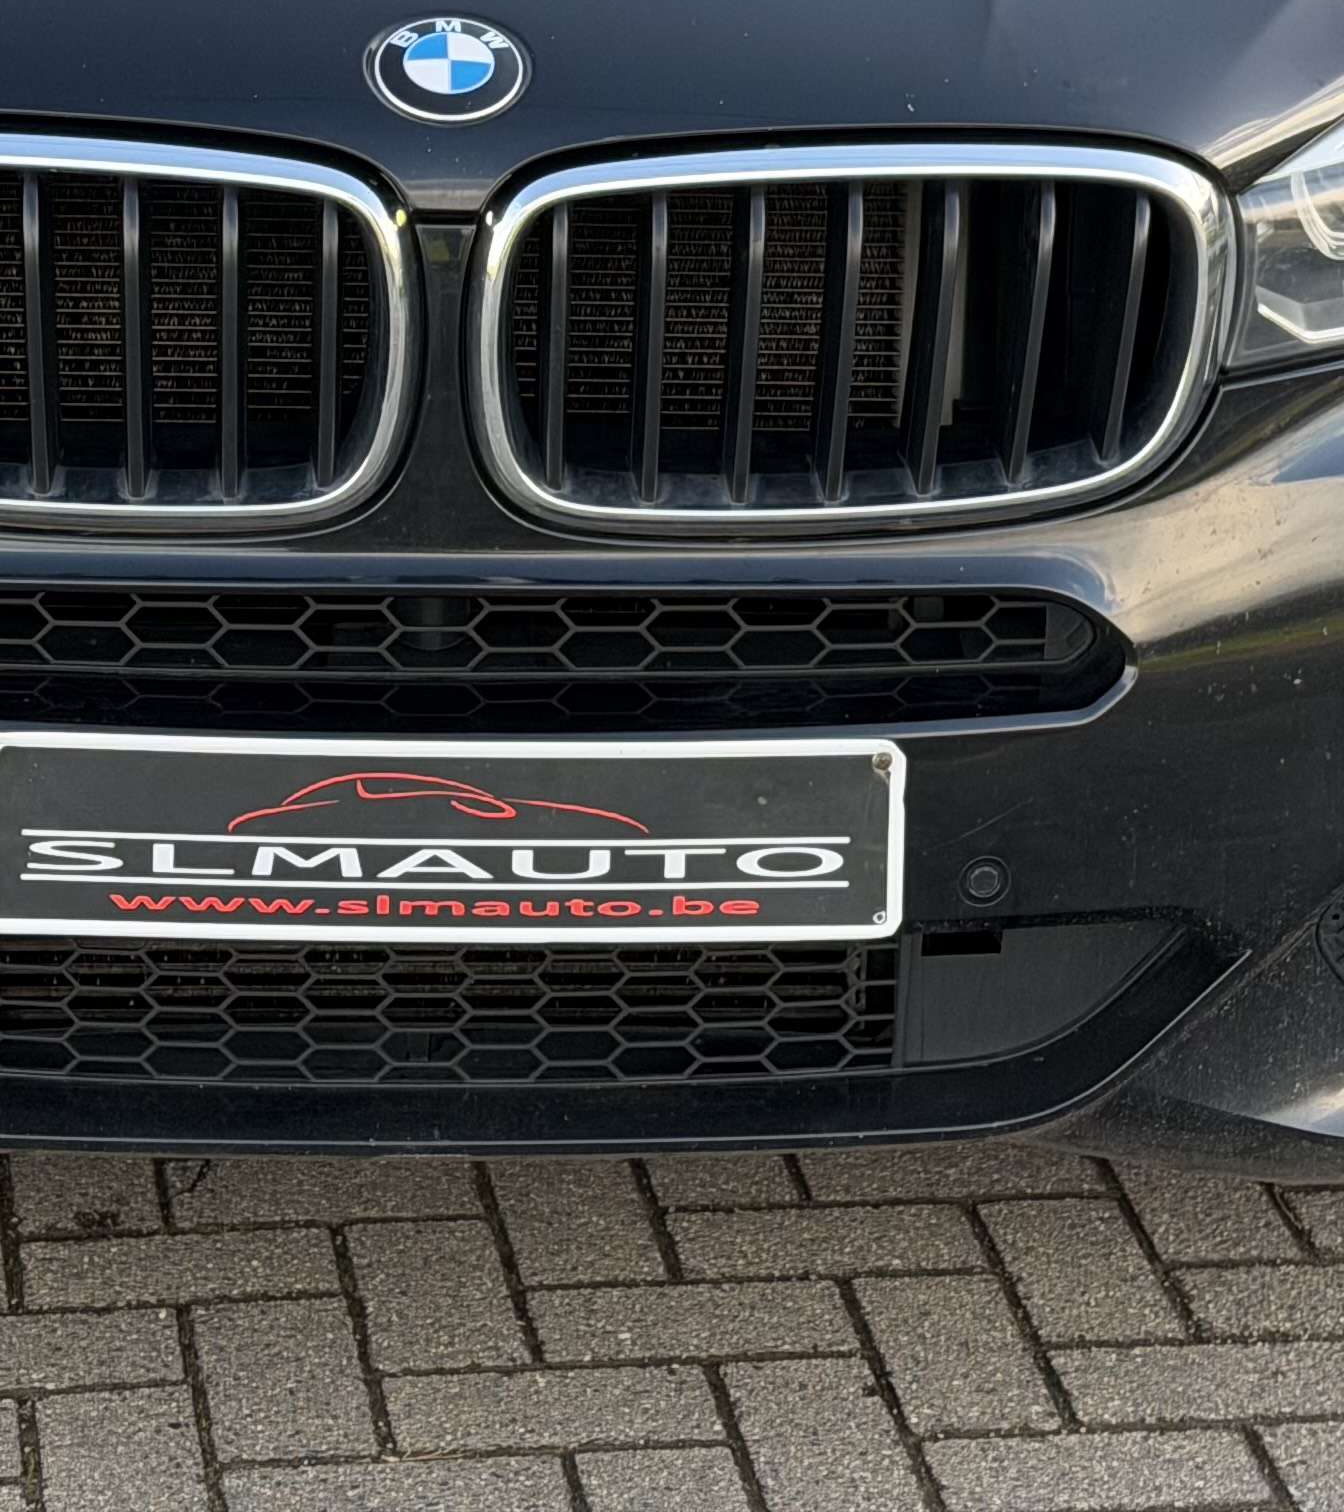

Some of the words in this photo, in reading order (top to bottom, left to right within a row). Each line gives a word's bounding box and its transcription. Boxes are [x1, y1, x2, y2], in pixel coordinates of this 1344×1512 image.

[390, 19, 509, 49] BMW
[27, 840, 844, 880] SLMAUTO
[109, 893, 760, 917] www.slmauto.be
